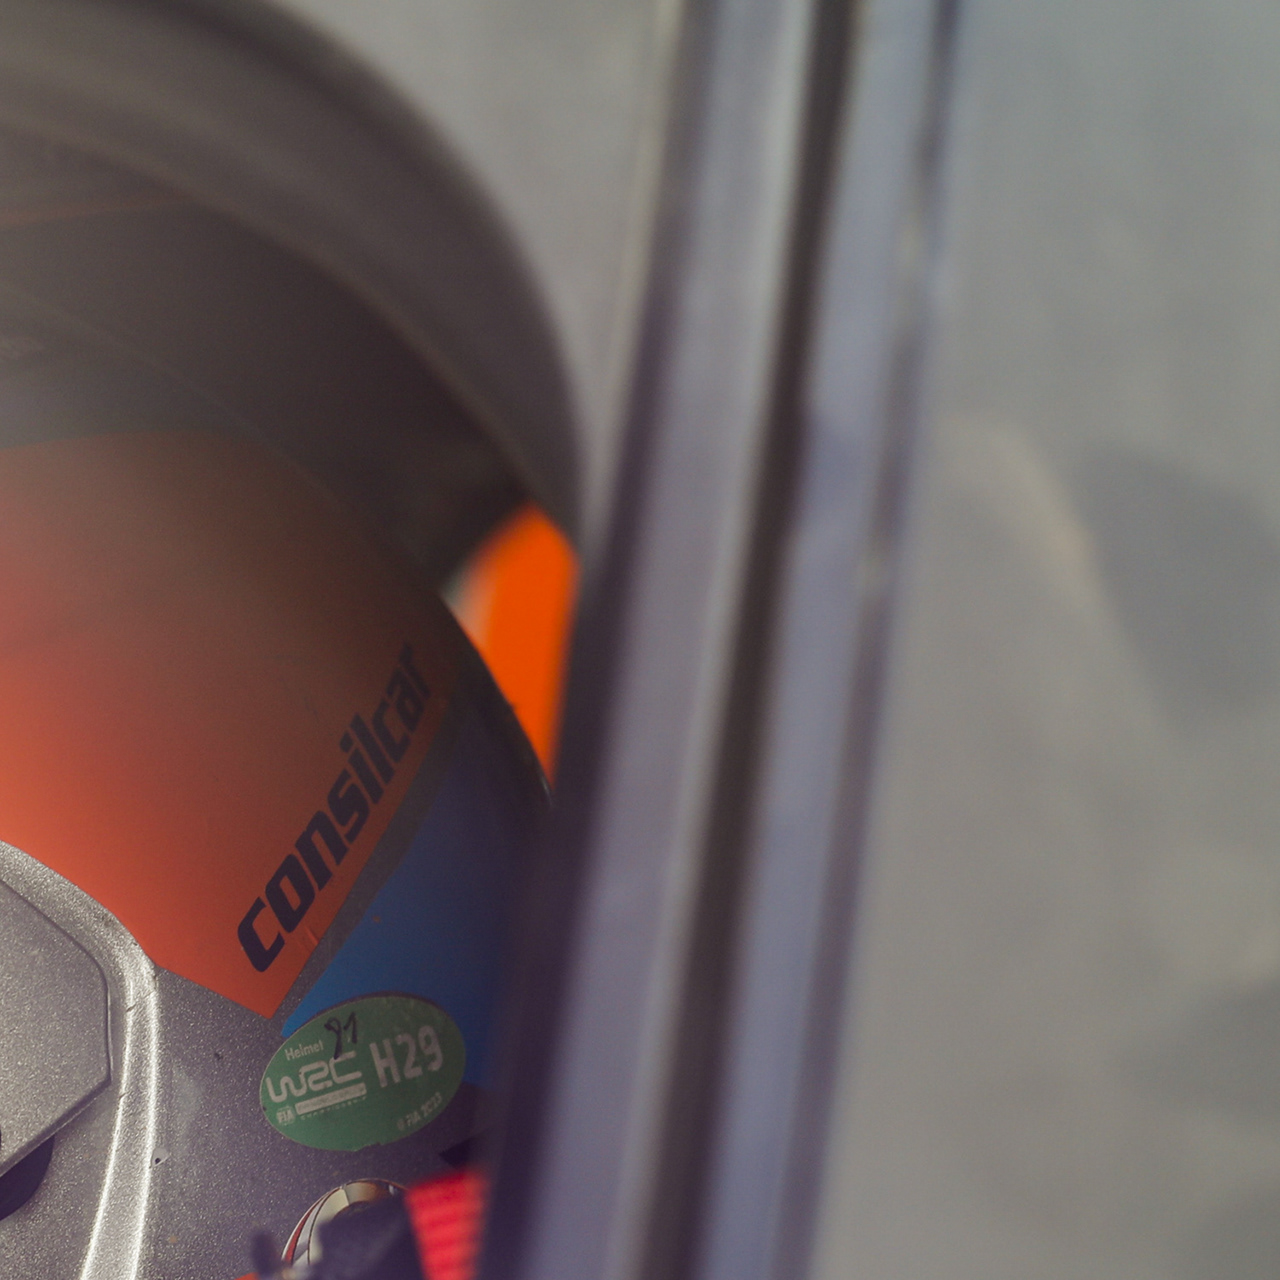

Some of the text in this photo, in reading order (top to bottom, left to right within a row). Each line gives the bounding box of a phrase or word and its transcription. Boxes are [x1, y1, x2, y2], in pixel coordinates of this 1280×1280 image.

[236, 640, 432, 974] consilcar
[264, 1050, 363, 1104] WRC
[284, 1039, 325, 1061] Helmet
[369, 1024, 444, 1089] H29
